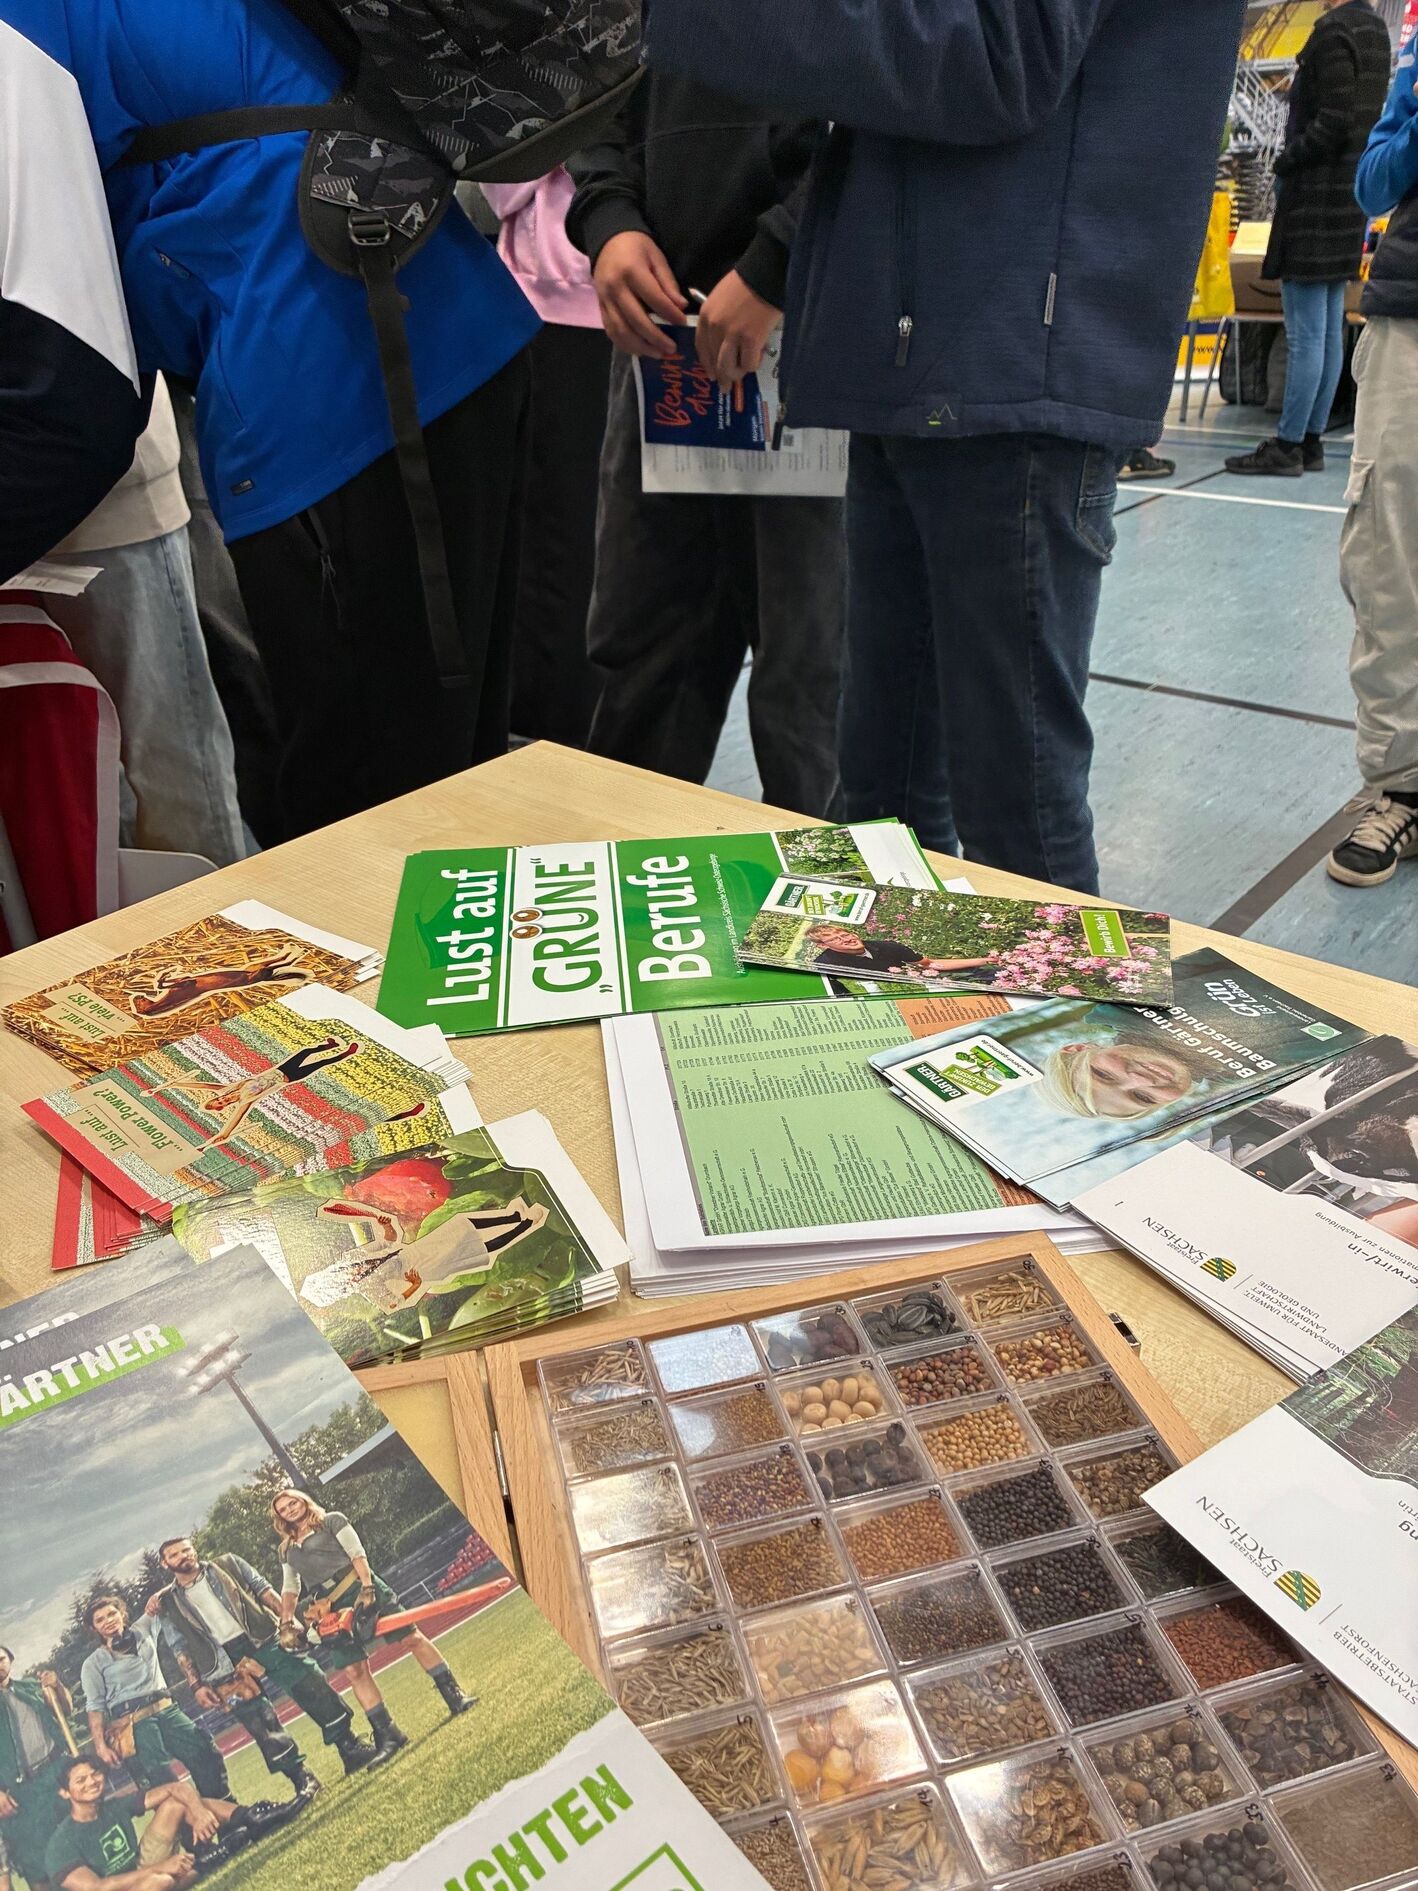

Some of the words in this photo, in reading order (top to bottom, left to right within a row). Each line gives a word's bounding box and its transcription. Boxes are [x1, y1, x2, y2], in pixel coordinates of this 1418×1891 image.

[441, 869, 498, 919] auf
[626, 855, 712, 982] Berufe
[1093, 914, 1110, 931] Dich!
[1099, 931, 1116, 953] Bewirb
[427, 927, 495, 1005] Lust
[67, 992, 88, 1008] PS?
[1204, 981, 1261, 1017] Grün
[81, 1020, 106, 1040] Lust
[1133, 1006, 1203, 1048] Gärtner
[1169, 1004, 1278, 1071] Baumschulg
[1198, 1046, 1257, 1079] Beruf
[93, 1088, 136, 1121] Power?
[100, 1125, 129, 1152] Lust
[1141, 1216, 1208, 1262] SACHSEN
[1314, 1211, 1362, 1243] Ausbildung
[1167, 1242, 1200, 1266] Freistaat
[1362, 1238, 1378, 1249] zur
[1023, 1260, 1035, 1272] 50
[1347, 1243, 1418, 1290] erwirt/-in
[1250, 1286, 1328, 1333] LANDWIRTSCHAFT
[1257, 1280, 1300, 1307] GEOLOGIE
[1300, 1304, 1321, 1319] UND
[1300, 1325, 1347, 1357] ANDESAMT
[1195, 1496, 1284, 1574] SACHSEN
[1228, 1538, 1273, 1579] Freistaat
[708, 1623, 723, 1631] 6
[1333, 1630, 1418, 1706] STAATSBETRIEB
[1341, 1623, 1418, 1692] ACHSENFORST
[737, 1715, 753, 1728] 5
[769, 1816, 785, 1825] 4
[1245, 1803, 1263, 1821] 33
[1113, 1852, 1132, 1869] 23
